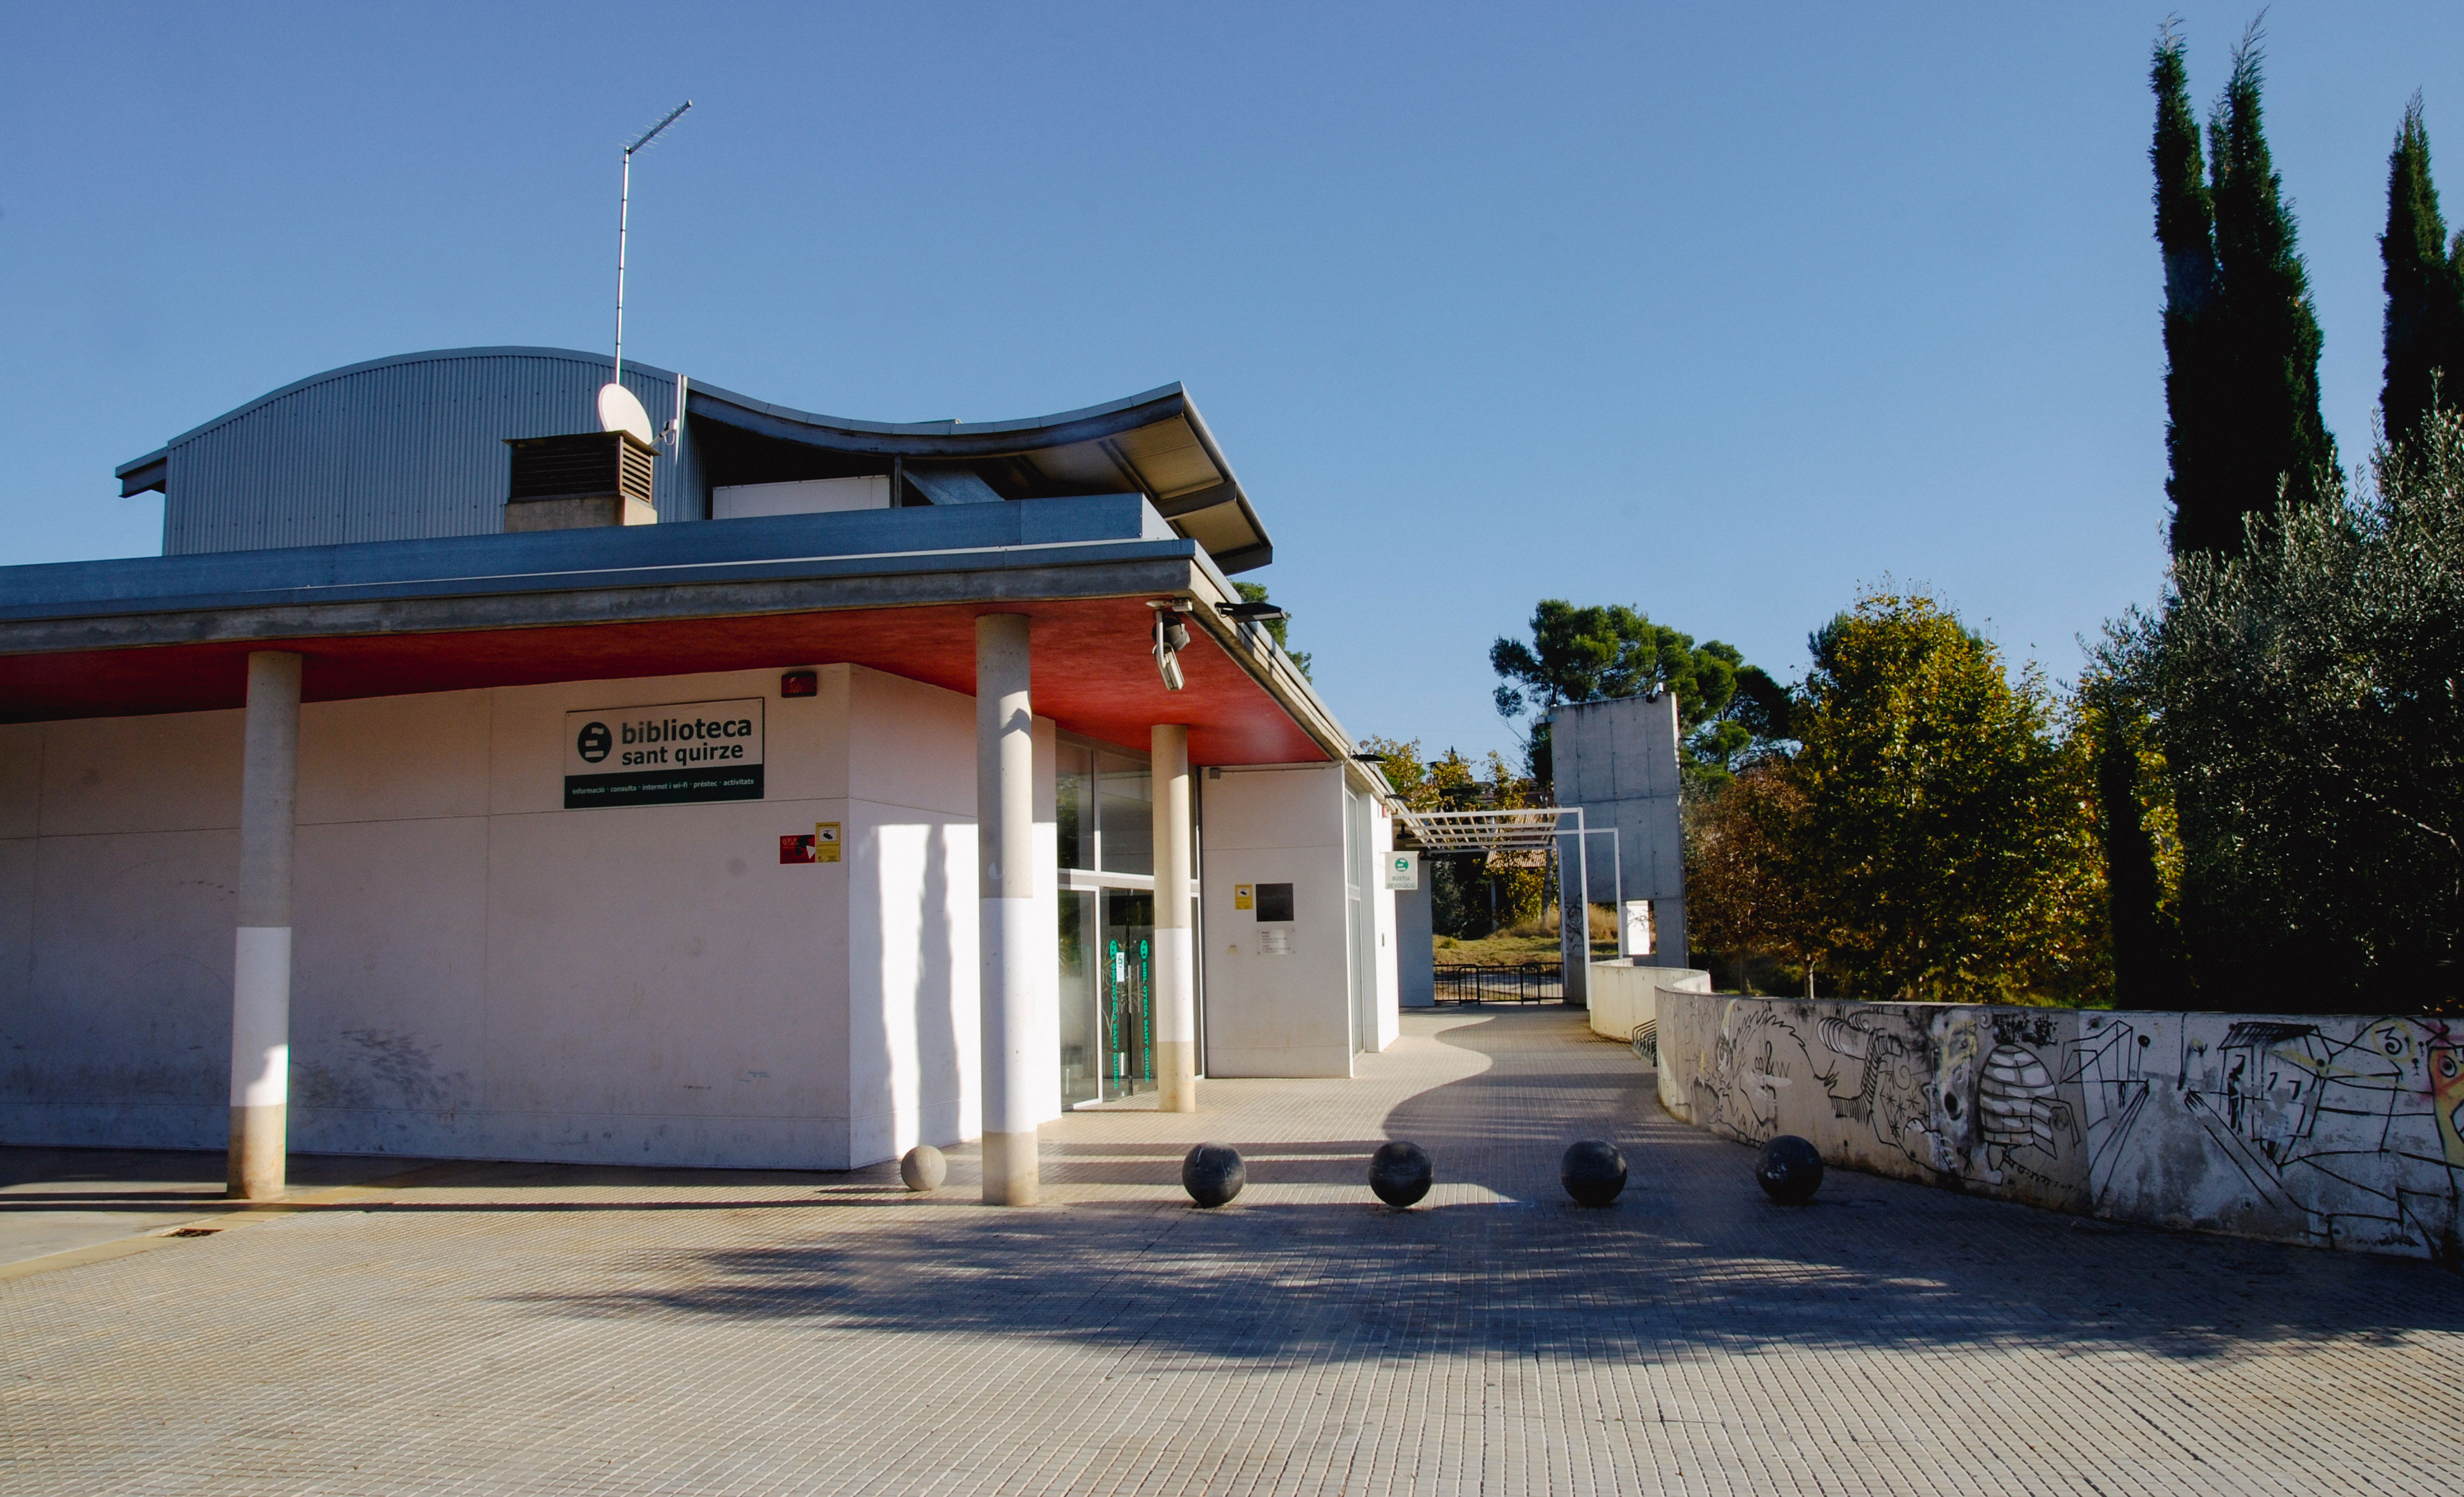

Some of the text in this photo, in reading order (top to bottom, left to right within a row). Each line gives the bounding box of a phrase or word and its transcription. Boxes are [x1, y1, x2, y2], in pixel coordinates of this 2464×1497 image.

[622, 718, 752, 745] biblioteca
[622, 742, 744, 766] sant quirze
[572, 785, 605, 795] informació
[642, 783, 668, 791] internet
[673, 781, 688, 789] wi-fi
[693, 780, 718, 789] préstec
[723, 778, 754, 786] activitats
